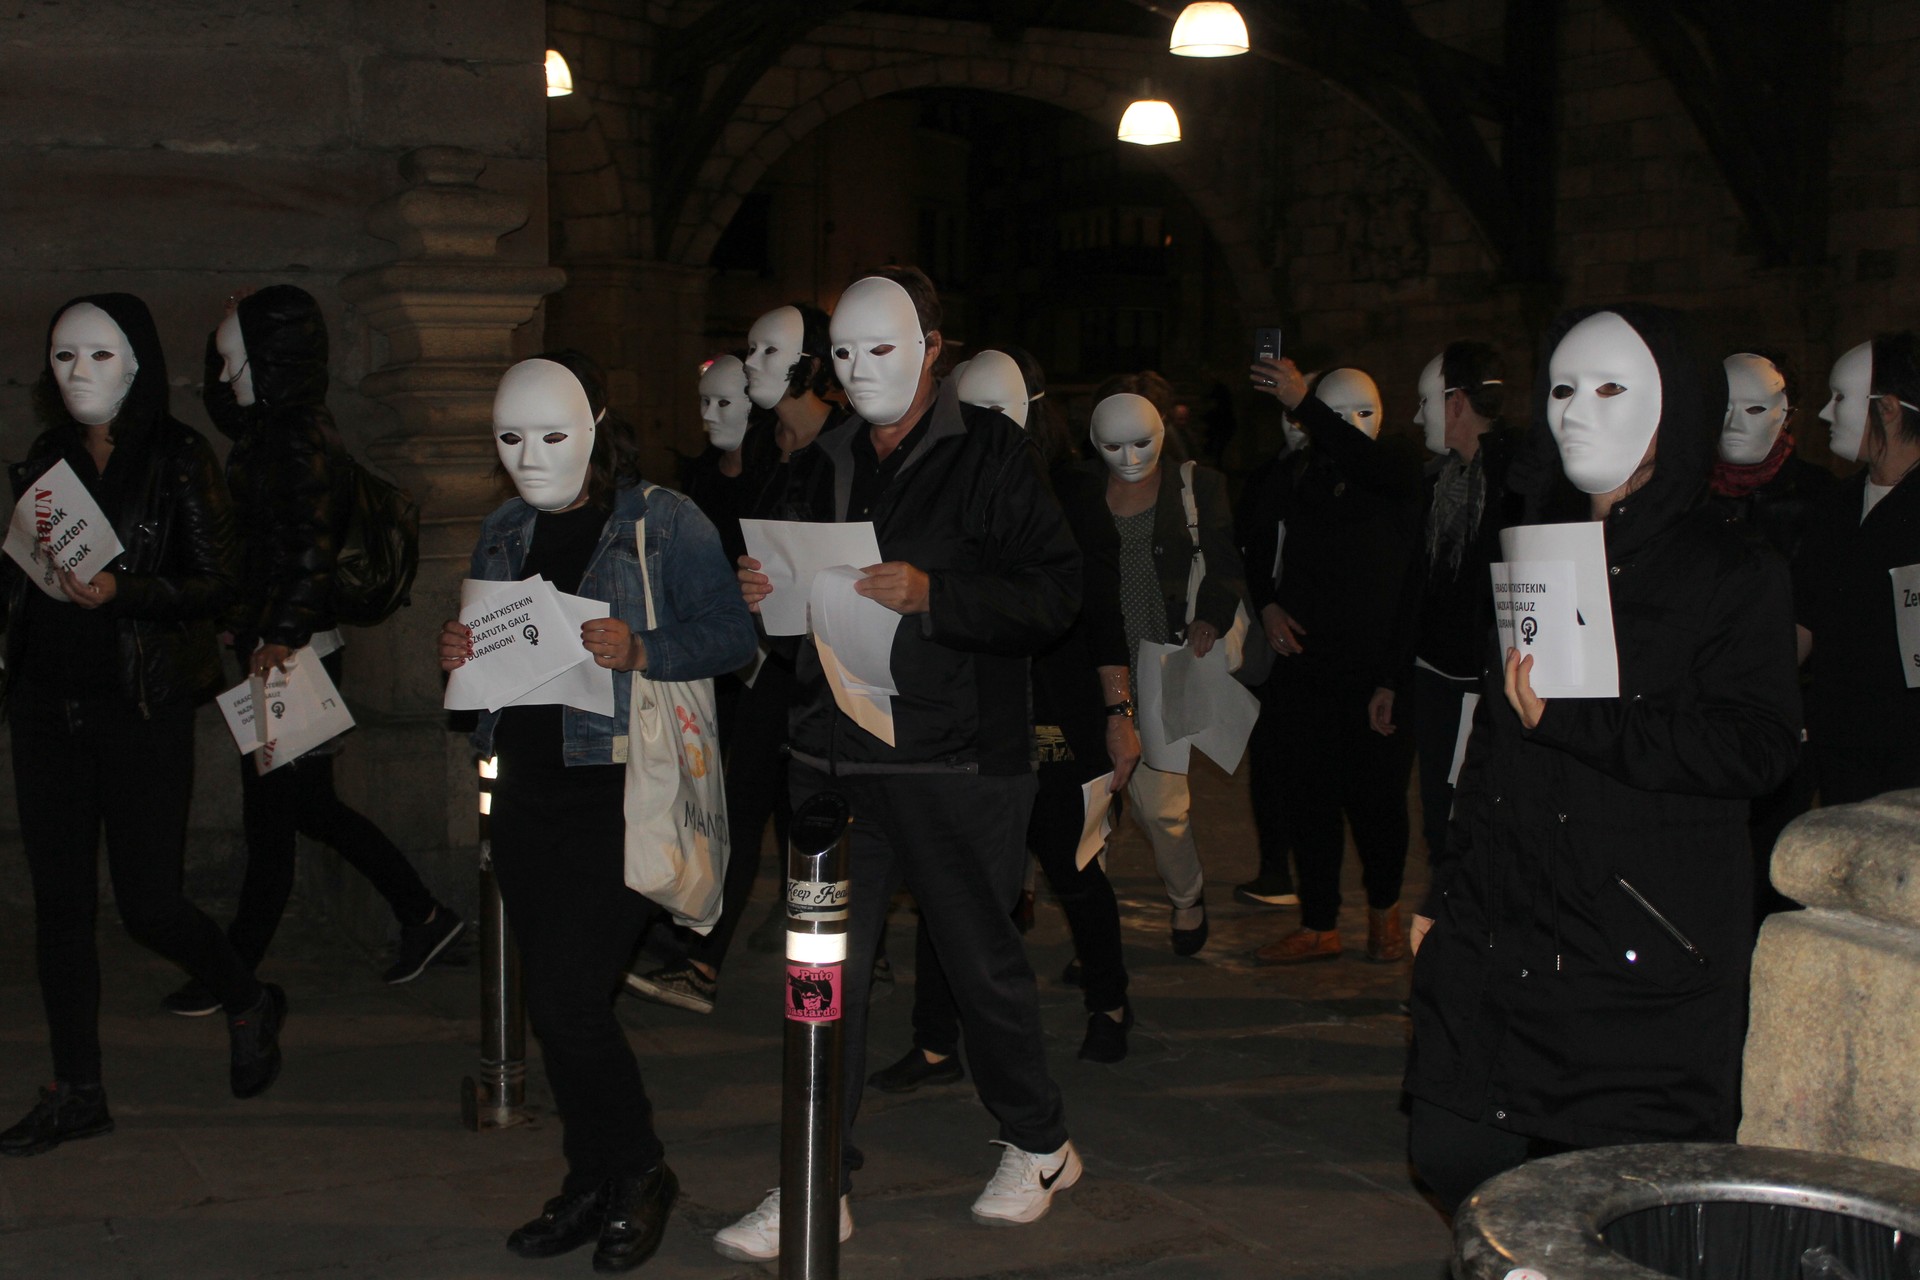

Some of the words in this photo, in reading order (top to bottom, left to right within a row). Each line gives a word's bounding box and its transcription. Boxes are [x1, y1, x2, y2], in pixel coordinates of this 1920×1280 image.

[481, 595, 533, 625] MATXISTEKIN
[472, 624, 508, 644] ZKATUTA
[507, 612, 531, 629] GAUZ
[800, 969, 833, 981] Puto
